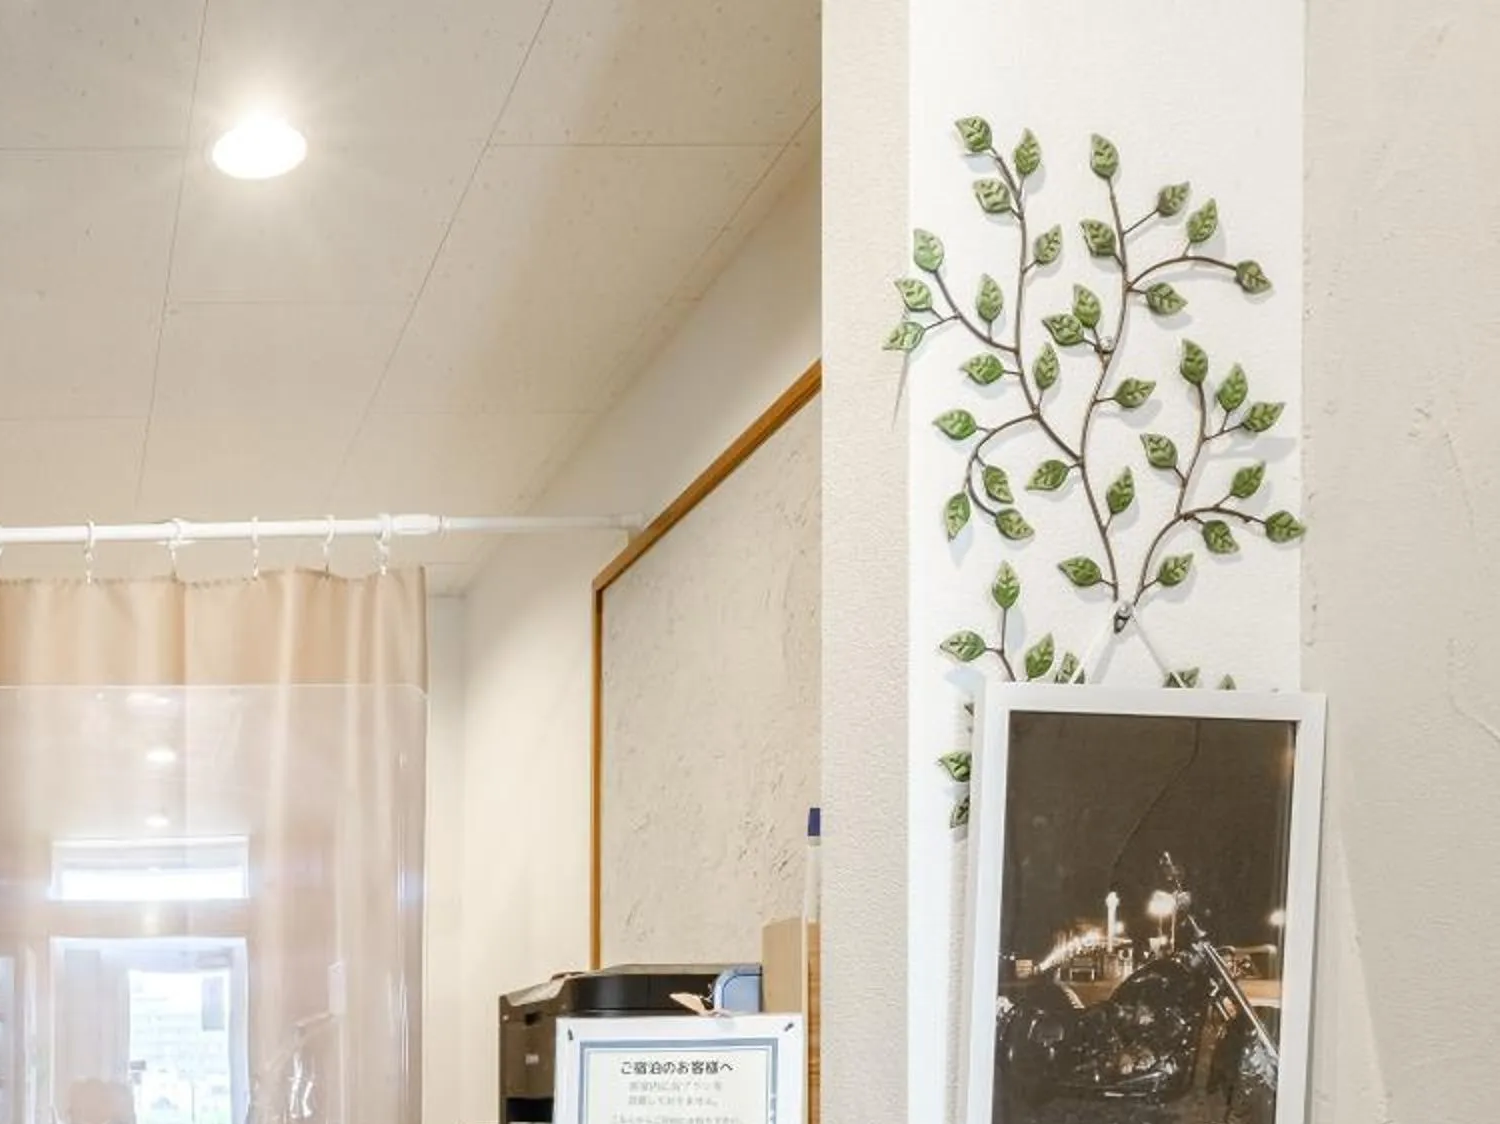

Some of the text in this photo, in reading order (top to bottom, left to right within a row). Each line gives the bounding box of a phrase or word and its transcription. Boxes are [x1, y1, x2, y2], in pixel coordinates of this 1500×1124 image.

[620, 1060, 734, 1076] ご宿泊のお客様へ
